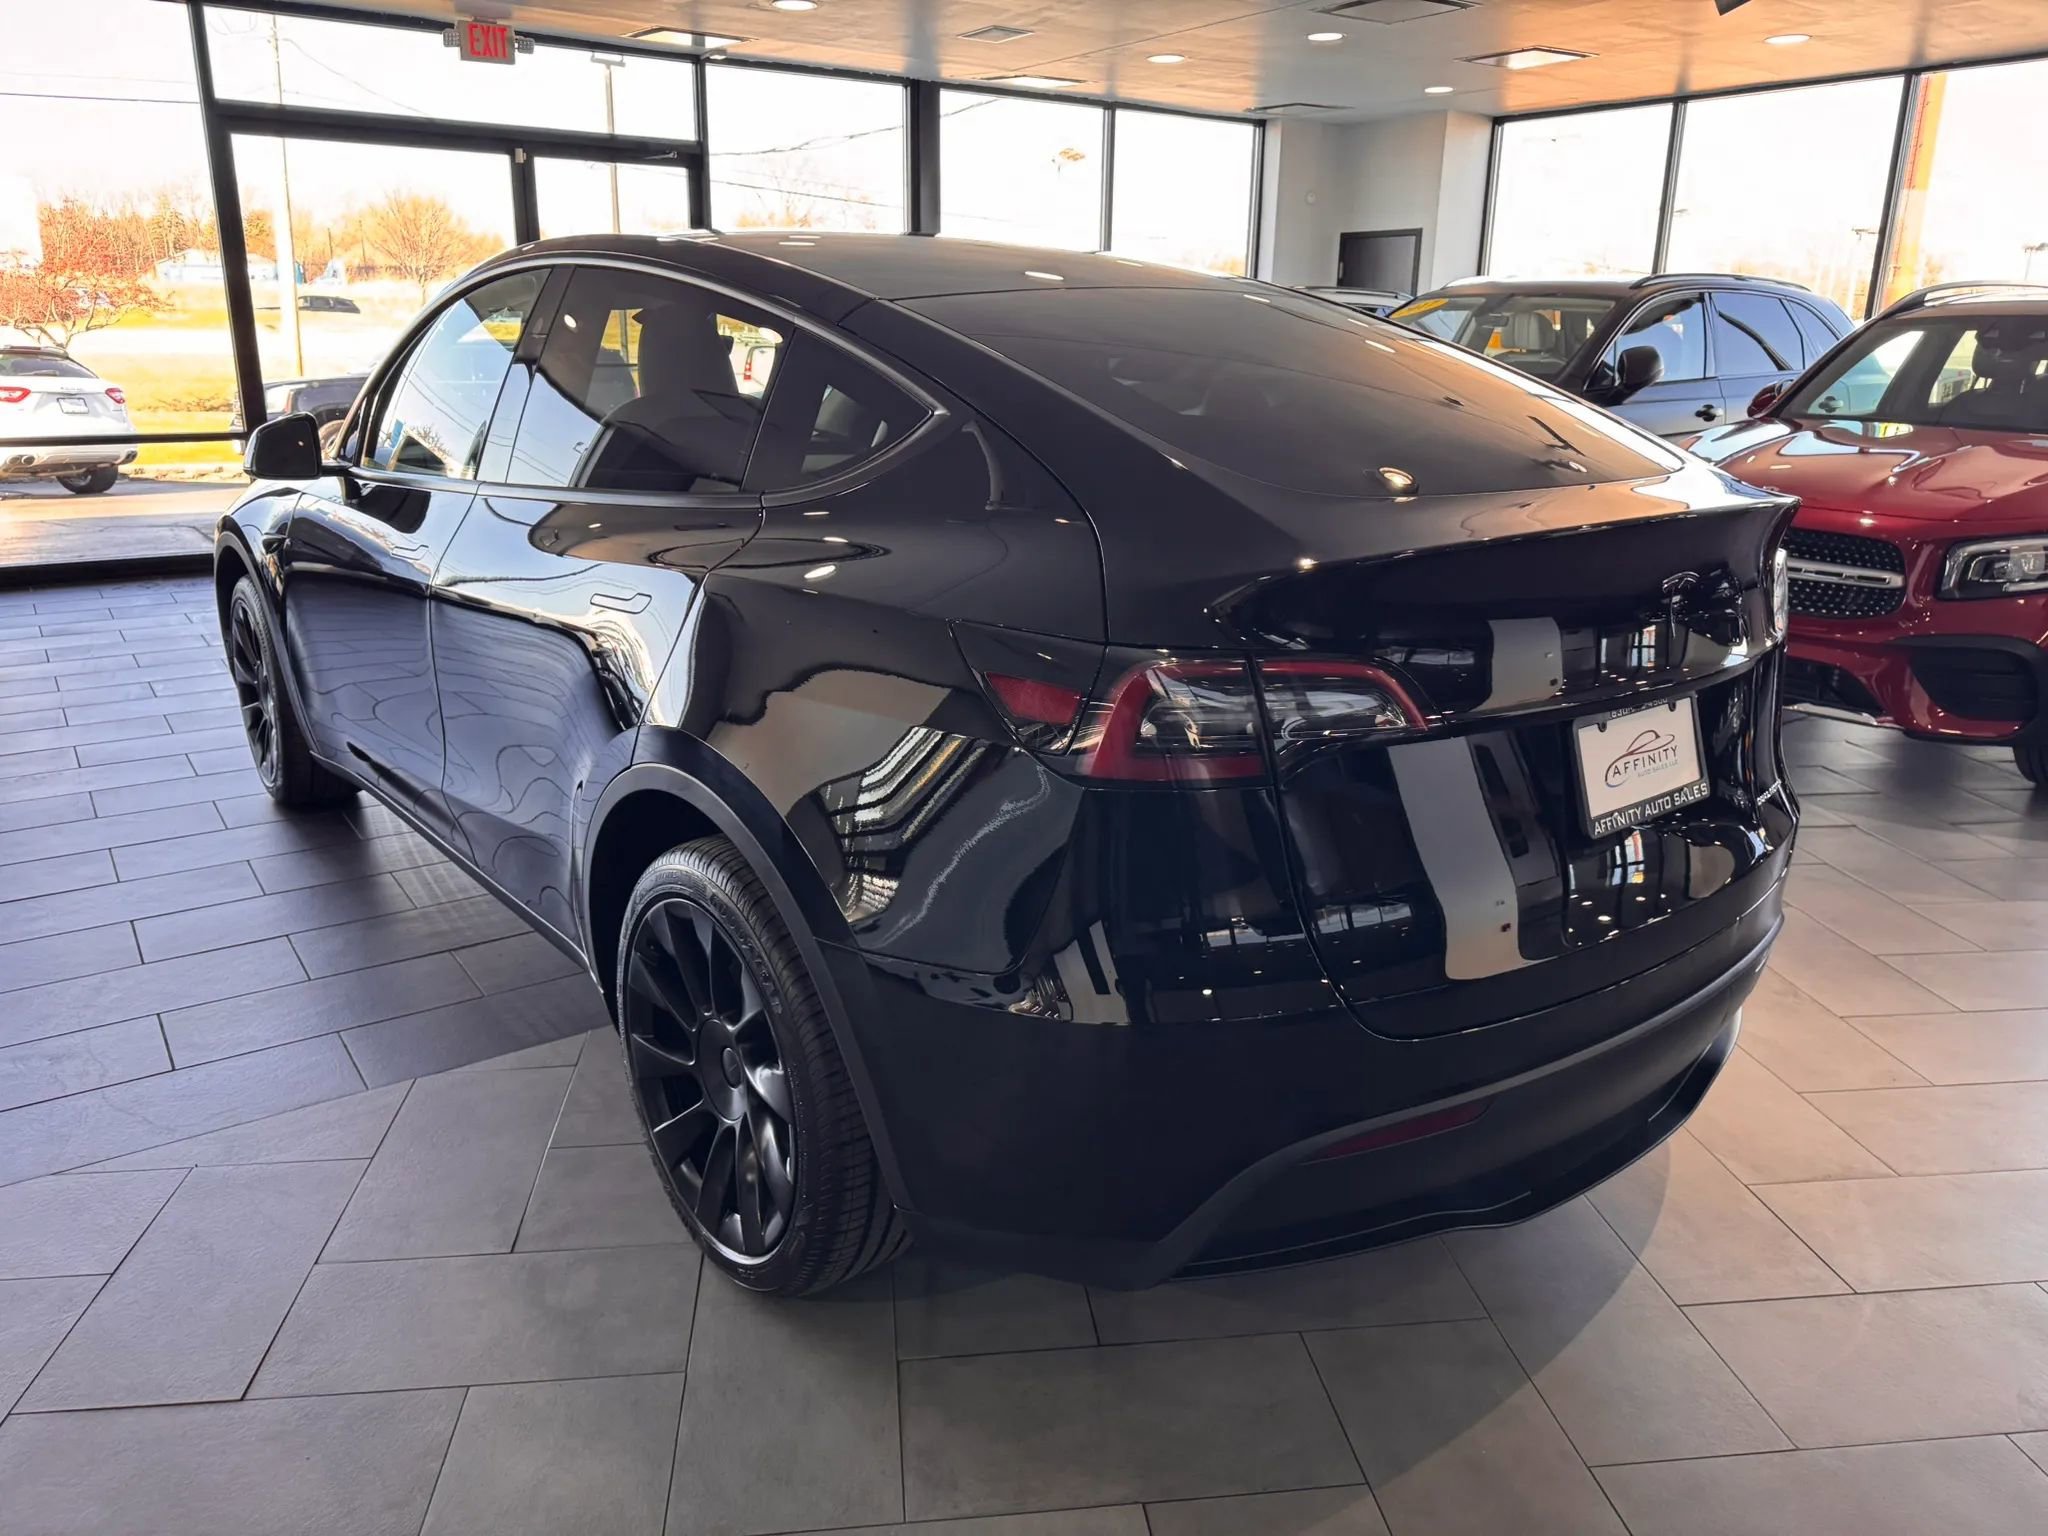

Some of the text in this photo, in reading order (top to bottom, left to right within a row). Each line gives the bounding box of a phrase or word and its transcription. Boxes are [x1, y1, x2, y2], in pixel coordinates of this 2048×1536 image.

[468, 23, 507, 57] EXIT
[1612, 745, 1678, 778] AFFINITY
[1594, 783, 1708, 836] AFFINITY AUTO SALES
